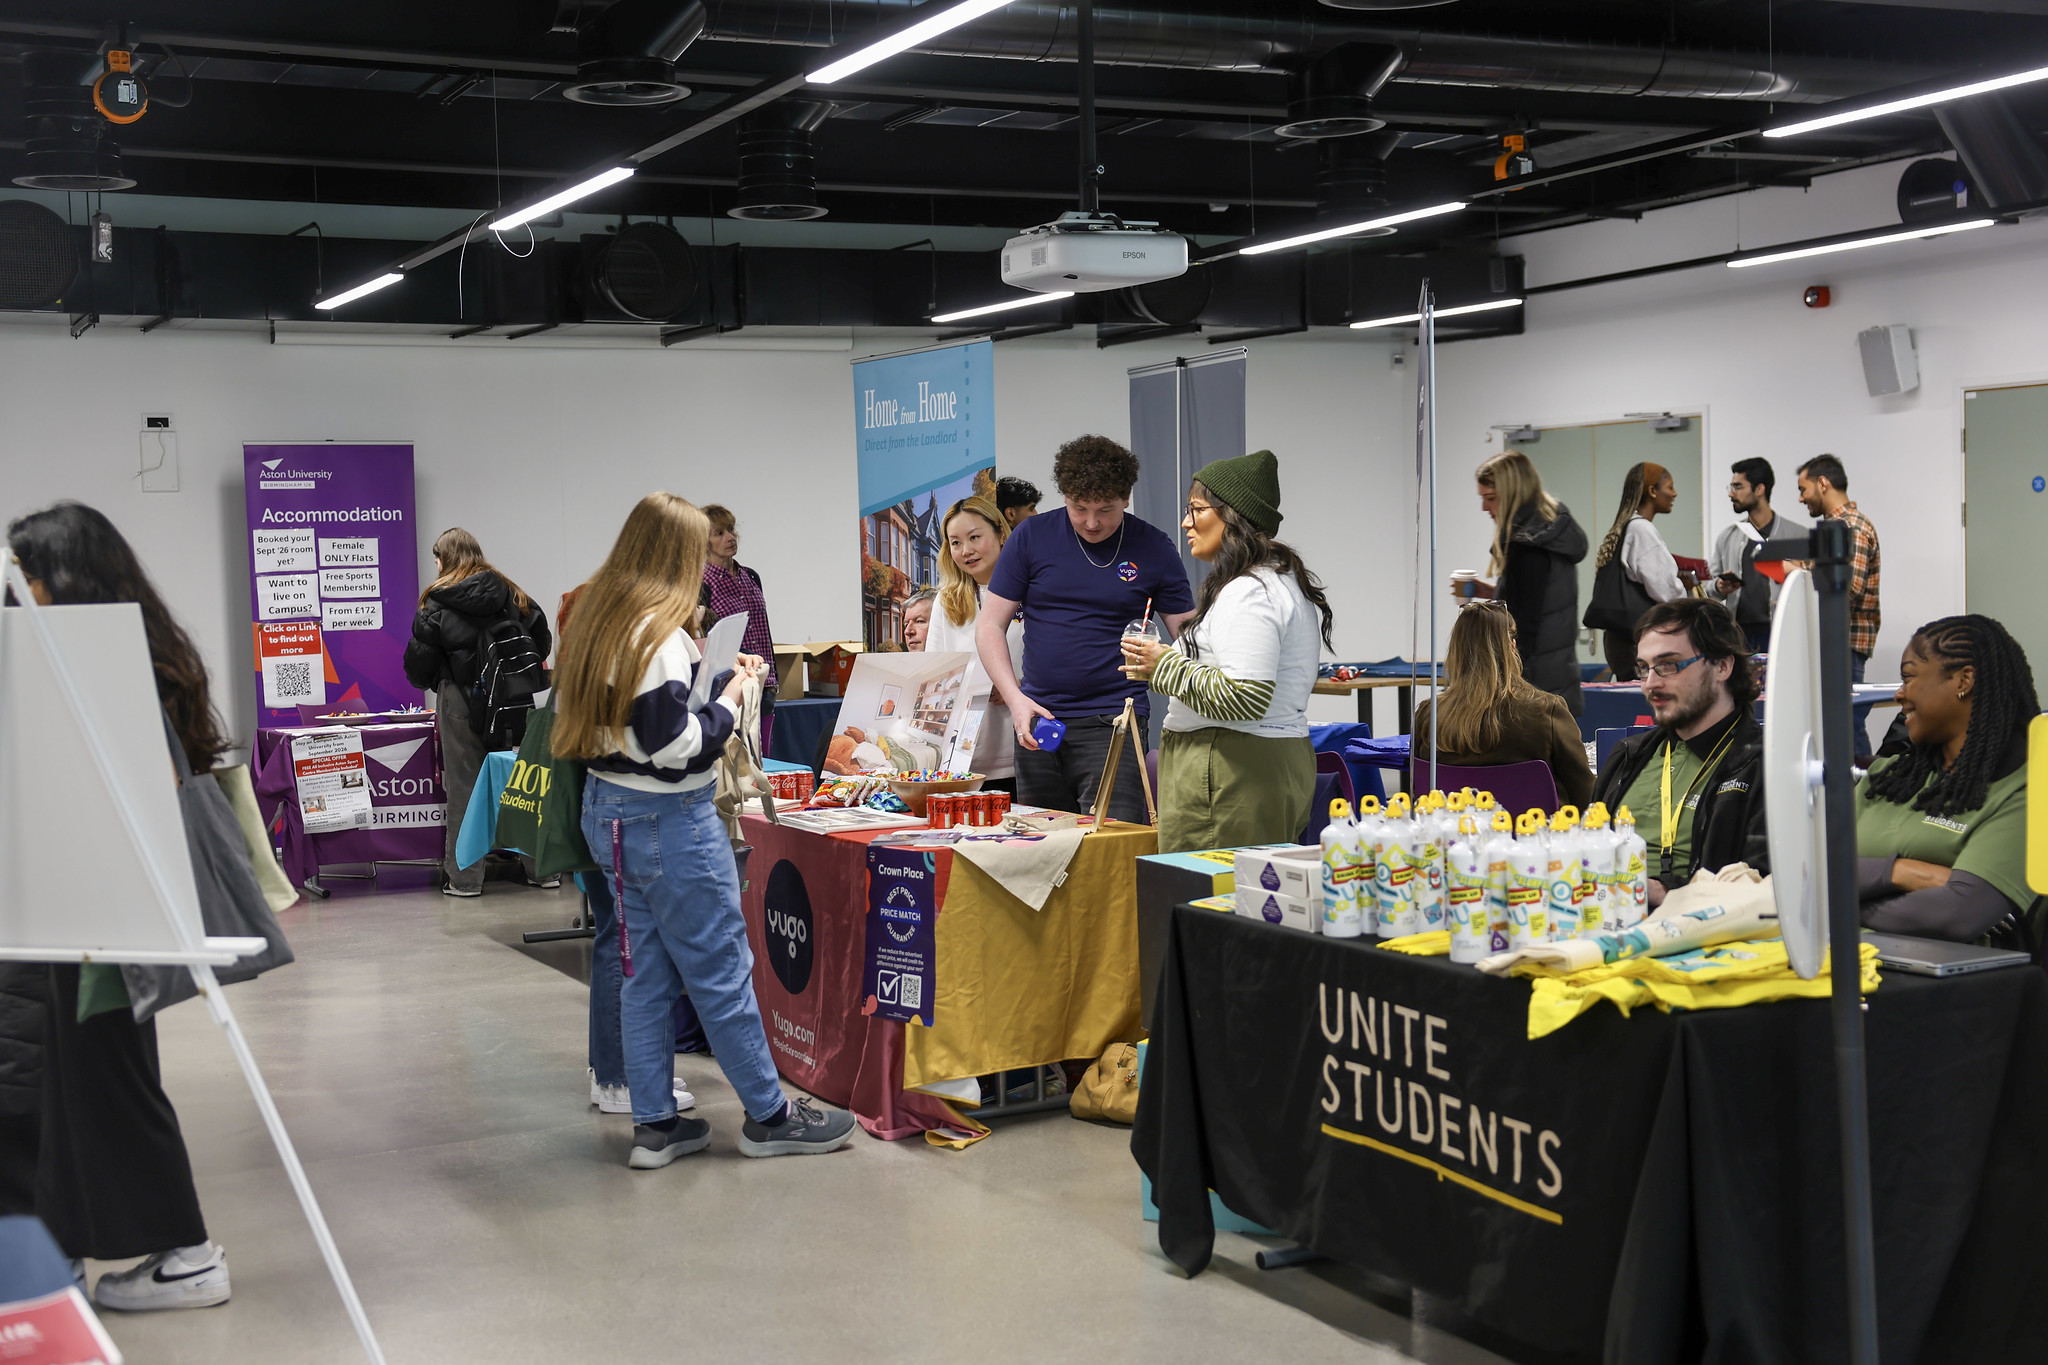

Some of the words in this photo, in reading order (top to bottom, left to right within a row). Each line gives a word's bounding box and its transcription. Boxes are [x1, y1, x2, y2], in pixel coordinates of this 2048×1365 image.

[1122, 251, 1146, 259] EPSON
[865, 389, 899, 429] Home
[900, 406, 916, 425] from
[918, 381, 957, 423] Home
[865, 438, 887, 452] Direct
[887, 436, 906, 452] from
[906, 434, 919, 447] the
[921, 429, 958, 446] Landlord
[260, 470, 286, 479] Aston
[287, 470, 333, 480] University
[261, 506, 402, 523] Accommodation
[257, 535, 289, 543] Booked
[290, 536, 311, 544] your
[256, 547, 275, 556] Sept
[332, 542, 365, 550] Female
[277, 558, 295, 567] yet?
[324, 554, 350, 562] ONLY
[352, 554, 374, 562] Flats
[346, 572, 373, 581] Sports
[268, 579, 295, 588] Want
[297, 578, 308, 586] to
[324, 583, 377, 593] Membership
[273, 592, 291, 601] live
[293, 592, 306, 600] on
[268, 604, 313, 615] Campus?
[329, 607, 352, 615] From
[354, 606, 376, 614] £172
[263, 624, 285, 633] Click
[298, 622, 317, 631] Link
[332, 620, 347, 629] per
[349, 618, 374, 626] week
[268, 636, 279, 644] to
[279, 634, 298, 643] find
[280, 646, 304, 654] more
[500, 791, 535, 813] Student
[1924, 815, 1968, 832] STUDENTS
[878, 864, 902, 877] Crown
[903, 866, 924, 879] Place
[886, 886, 900, 904] BEST
[900, 886, 916, 907] PRICE
[880, 907, 898, 918] PRICE
[898, 910, 921, 921] MATCH
[886, 922, 916, 942] GUARANTEE
[772, 1009, 815, 1046] Yugo.com
[1319, 982, 1450, 1081] UNITE
[1321, 1054, 1562, 1198] STUDENTS
